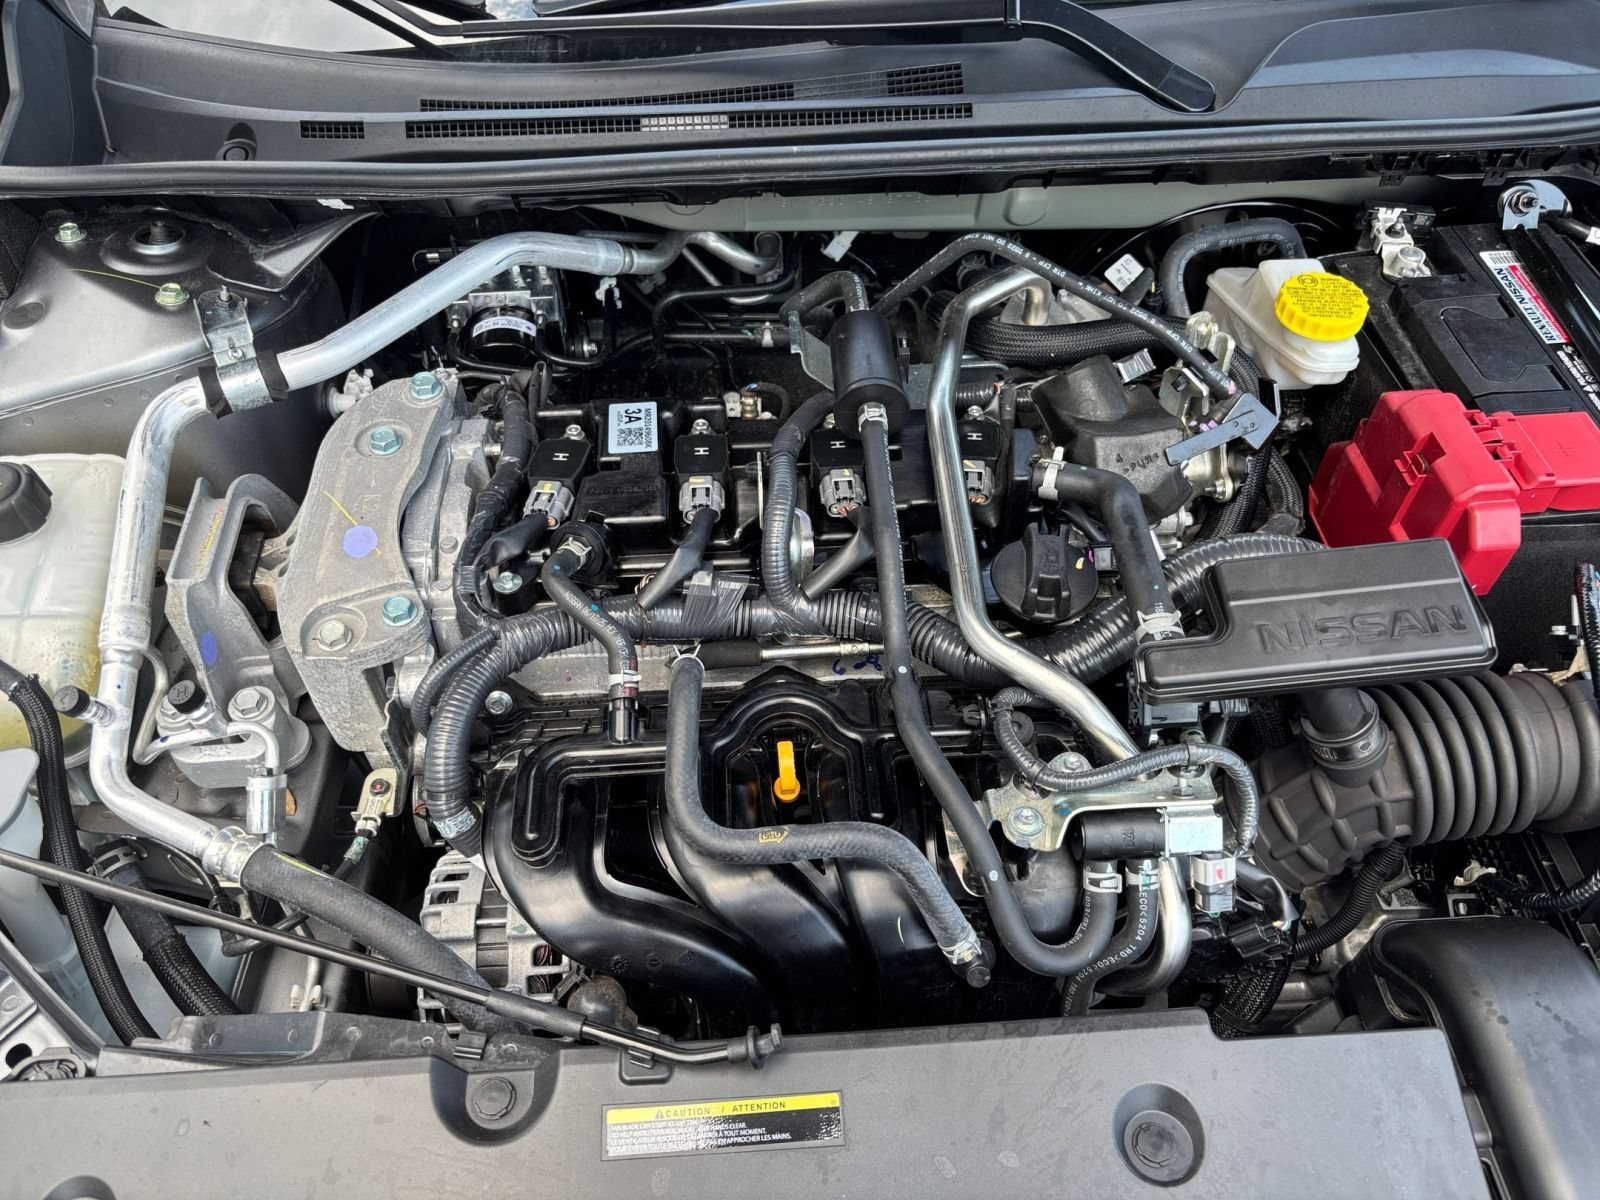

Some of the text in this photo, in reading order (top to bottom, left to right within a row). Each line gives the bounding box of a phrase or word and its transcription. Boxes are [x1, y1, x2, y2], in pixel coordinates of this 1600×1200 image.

[1494, 267, 1529, 305] NISSAN
[1524, 305, 1556, 342] RENAULT
[624, 408, 642, 424] 3A
[1256, 604, 1468, 653] NISSAN
[665, 1106, 711, 1118] CAUTION
[732, 1101, 786, 1112] ATTENTION
